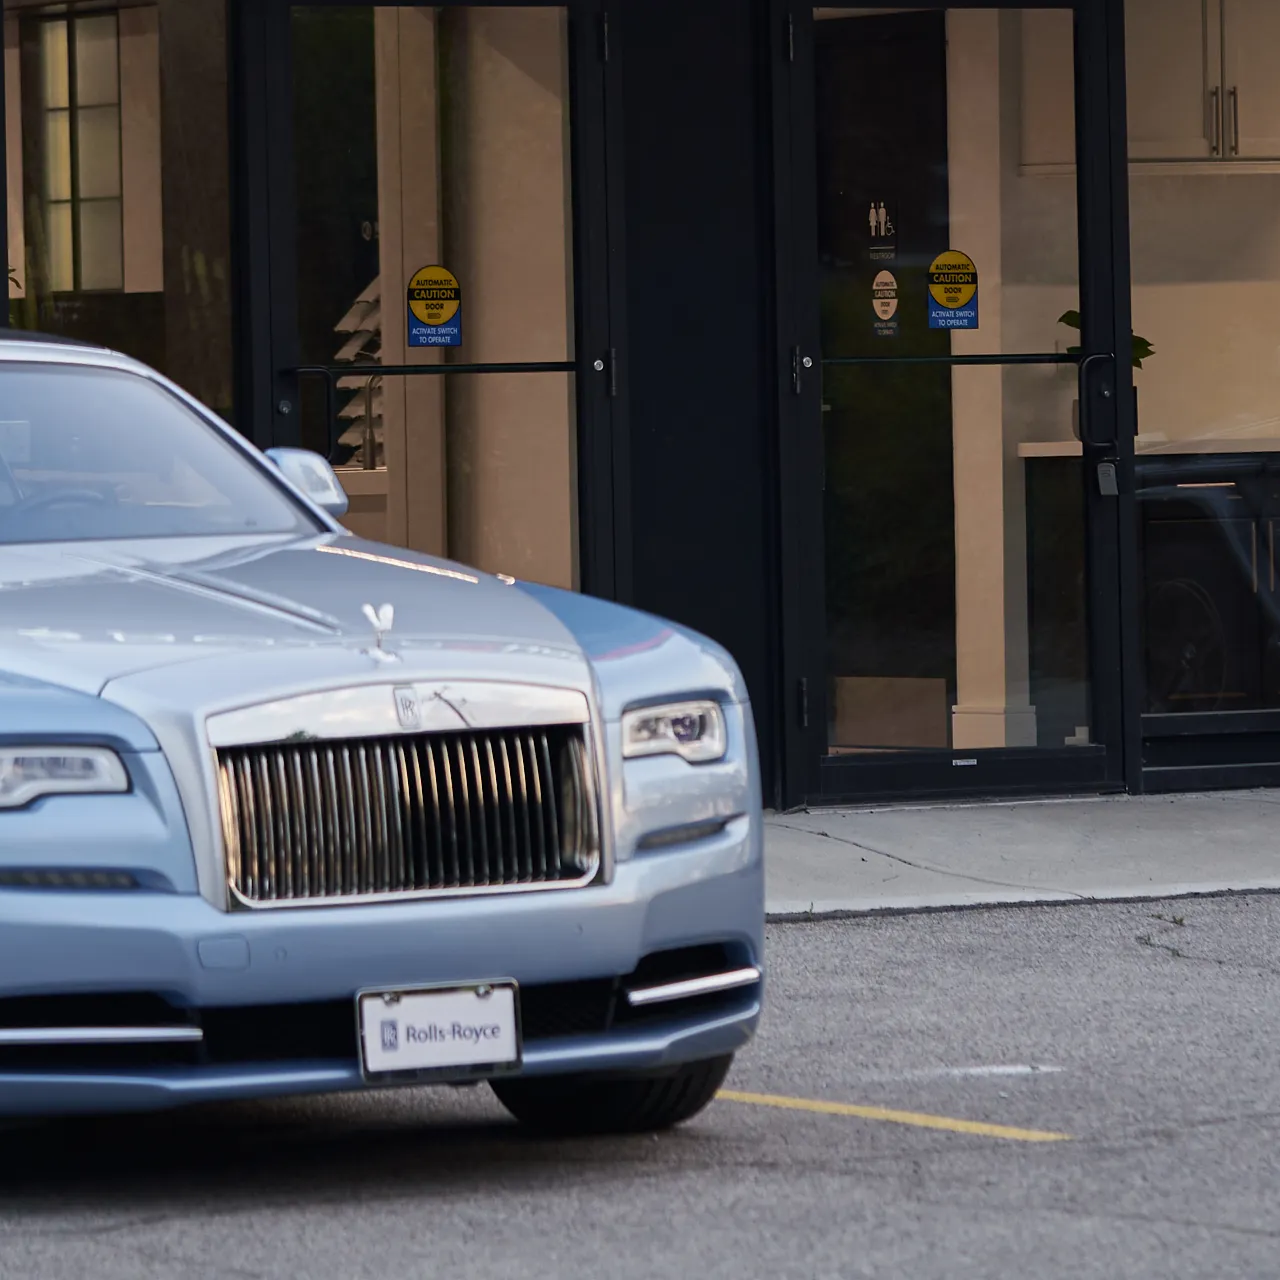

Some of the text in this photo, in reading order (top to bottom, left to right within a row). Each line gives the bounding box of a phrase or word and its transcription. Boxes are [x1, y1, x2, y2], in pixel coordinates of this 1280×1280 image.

[933, 274, 972, 283] CAUTION
[414, 290, 455, 298] CAUTION
[405, 1021, 501, 1045] Rolls-Royce
